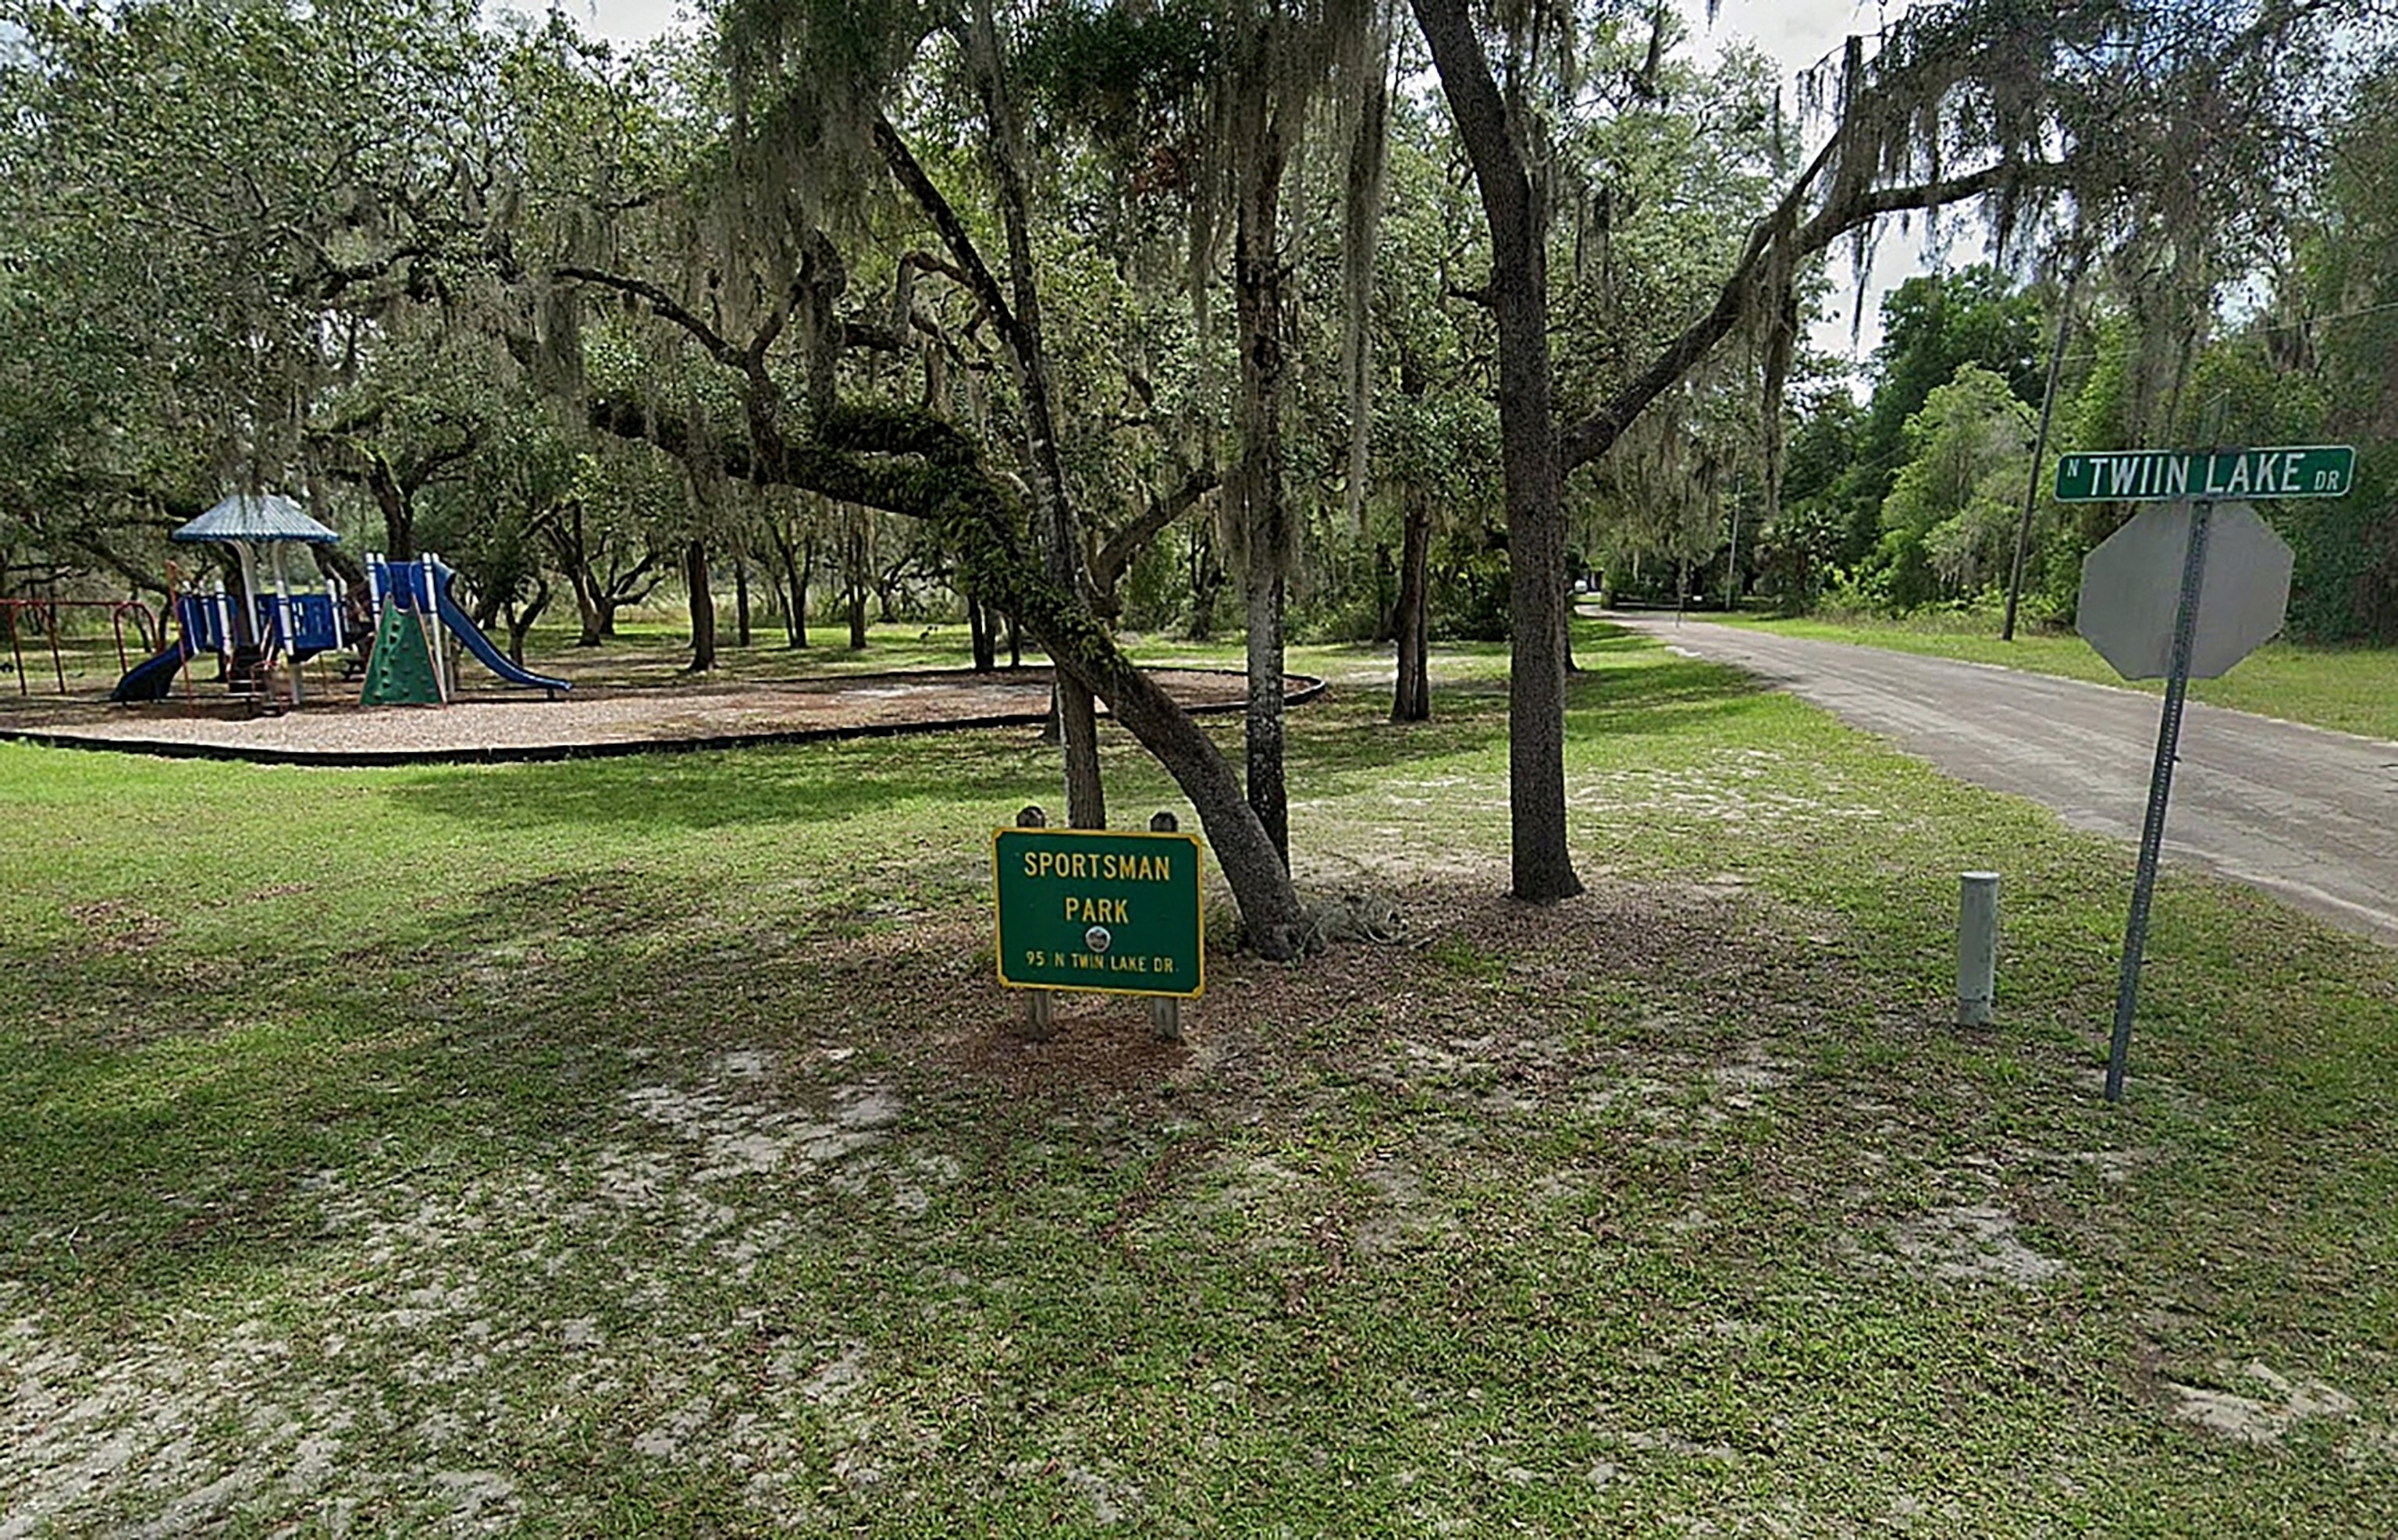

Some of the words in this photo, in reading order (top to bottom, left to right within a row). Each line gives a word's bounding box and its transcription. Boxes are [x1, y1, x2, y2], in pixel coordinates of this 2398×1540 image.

[2067, 460, 2080, 477] N
[2205, 453, 2305, 493] LAKE
[2314, 469, 2339, 491] DR
[1024, 852, 1170, 881] SPORTSMAN
[1066, 897, 1129, 924] PARK
[1026, 951, 1045, 966] 95
[1055, 952, 1065, 968] N
[1071, 953, 1105, 969] TWIN
[1111, 955, 1147, 972] LAKE
